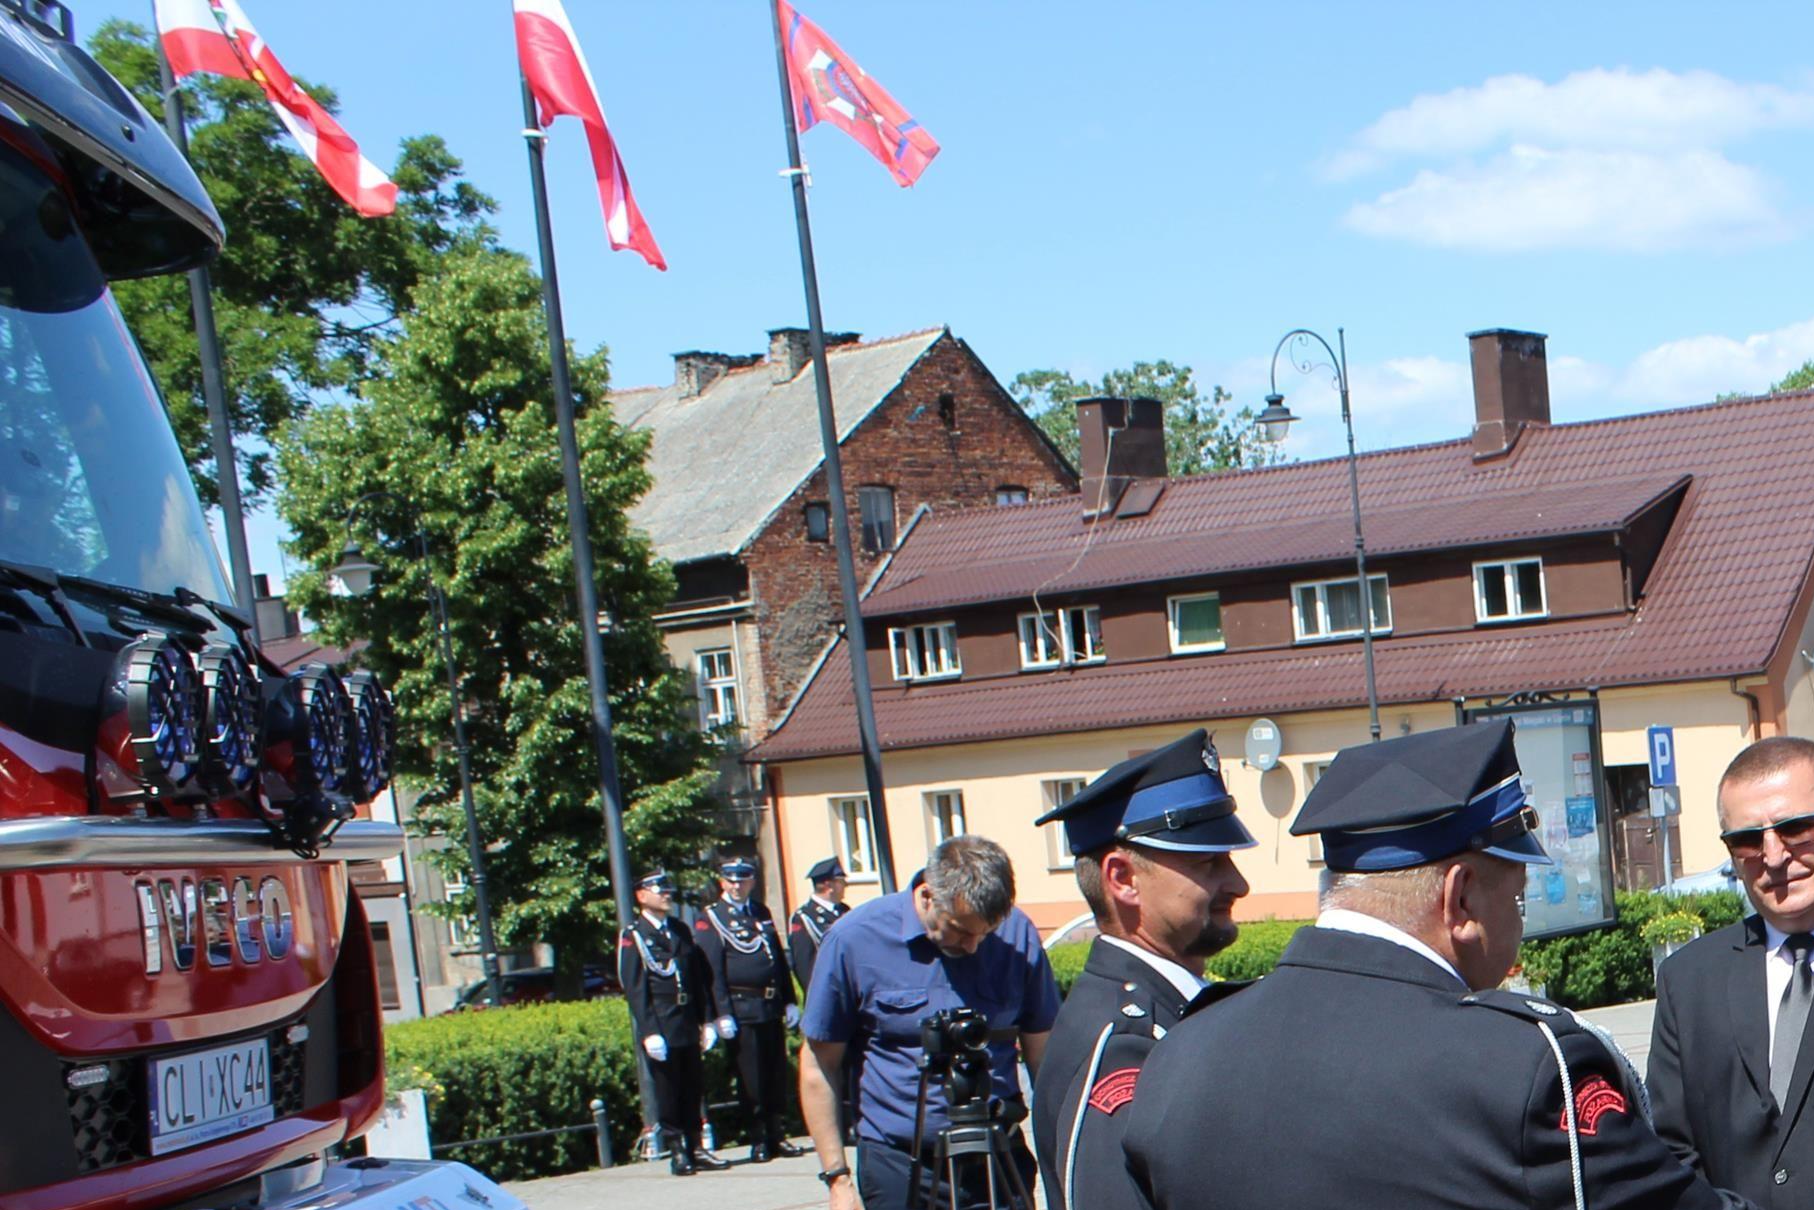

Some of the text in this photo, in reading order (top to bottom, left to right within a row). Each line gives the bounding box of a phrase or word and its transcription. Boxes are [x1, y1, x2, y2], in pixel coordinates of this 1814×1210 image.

[1654, 732, 1671, 780] P
[135, 876, 292, 974] IVECO
[164, 1047, 266, 1128] CLI XC44
